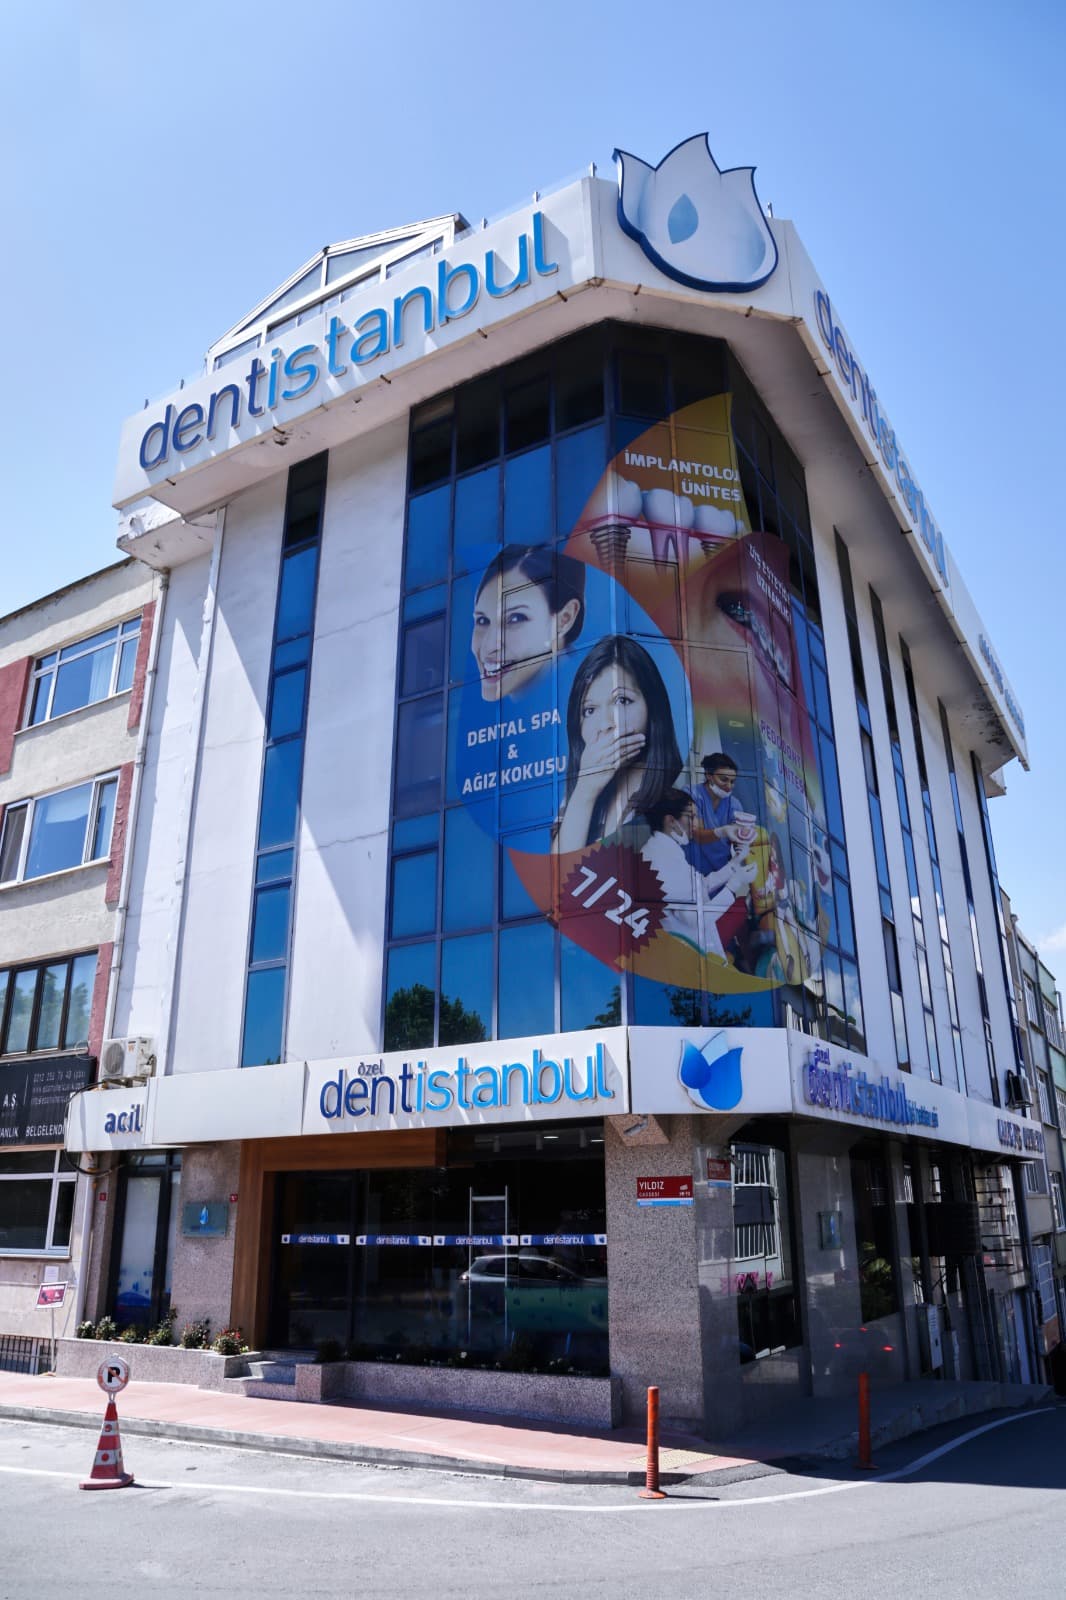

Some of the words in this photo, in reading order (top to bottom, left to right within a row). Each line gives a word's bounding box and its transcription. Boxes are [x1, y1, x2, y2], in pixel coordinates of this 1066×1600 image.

[138, 210, 558, 472] dentistanbul
[467, 718, 526, 747] DENTAL
[531, 708, 561, 730] SPA
[507, 743, 518, 760] &
[462, 772, 497, 795] AĞIZ
[500, 756, 566, 786] KOKUSU
[571, 866, 650, 939] 7/24
[320, 1042, 615, 1119] dentistanbul
[358, 1059, 383, 1076] özel
[104, 1104, 142, 1134] acil
[639, 1181, 665, 1190] YILDIZ
